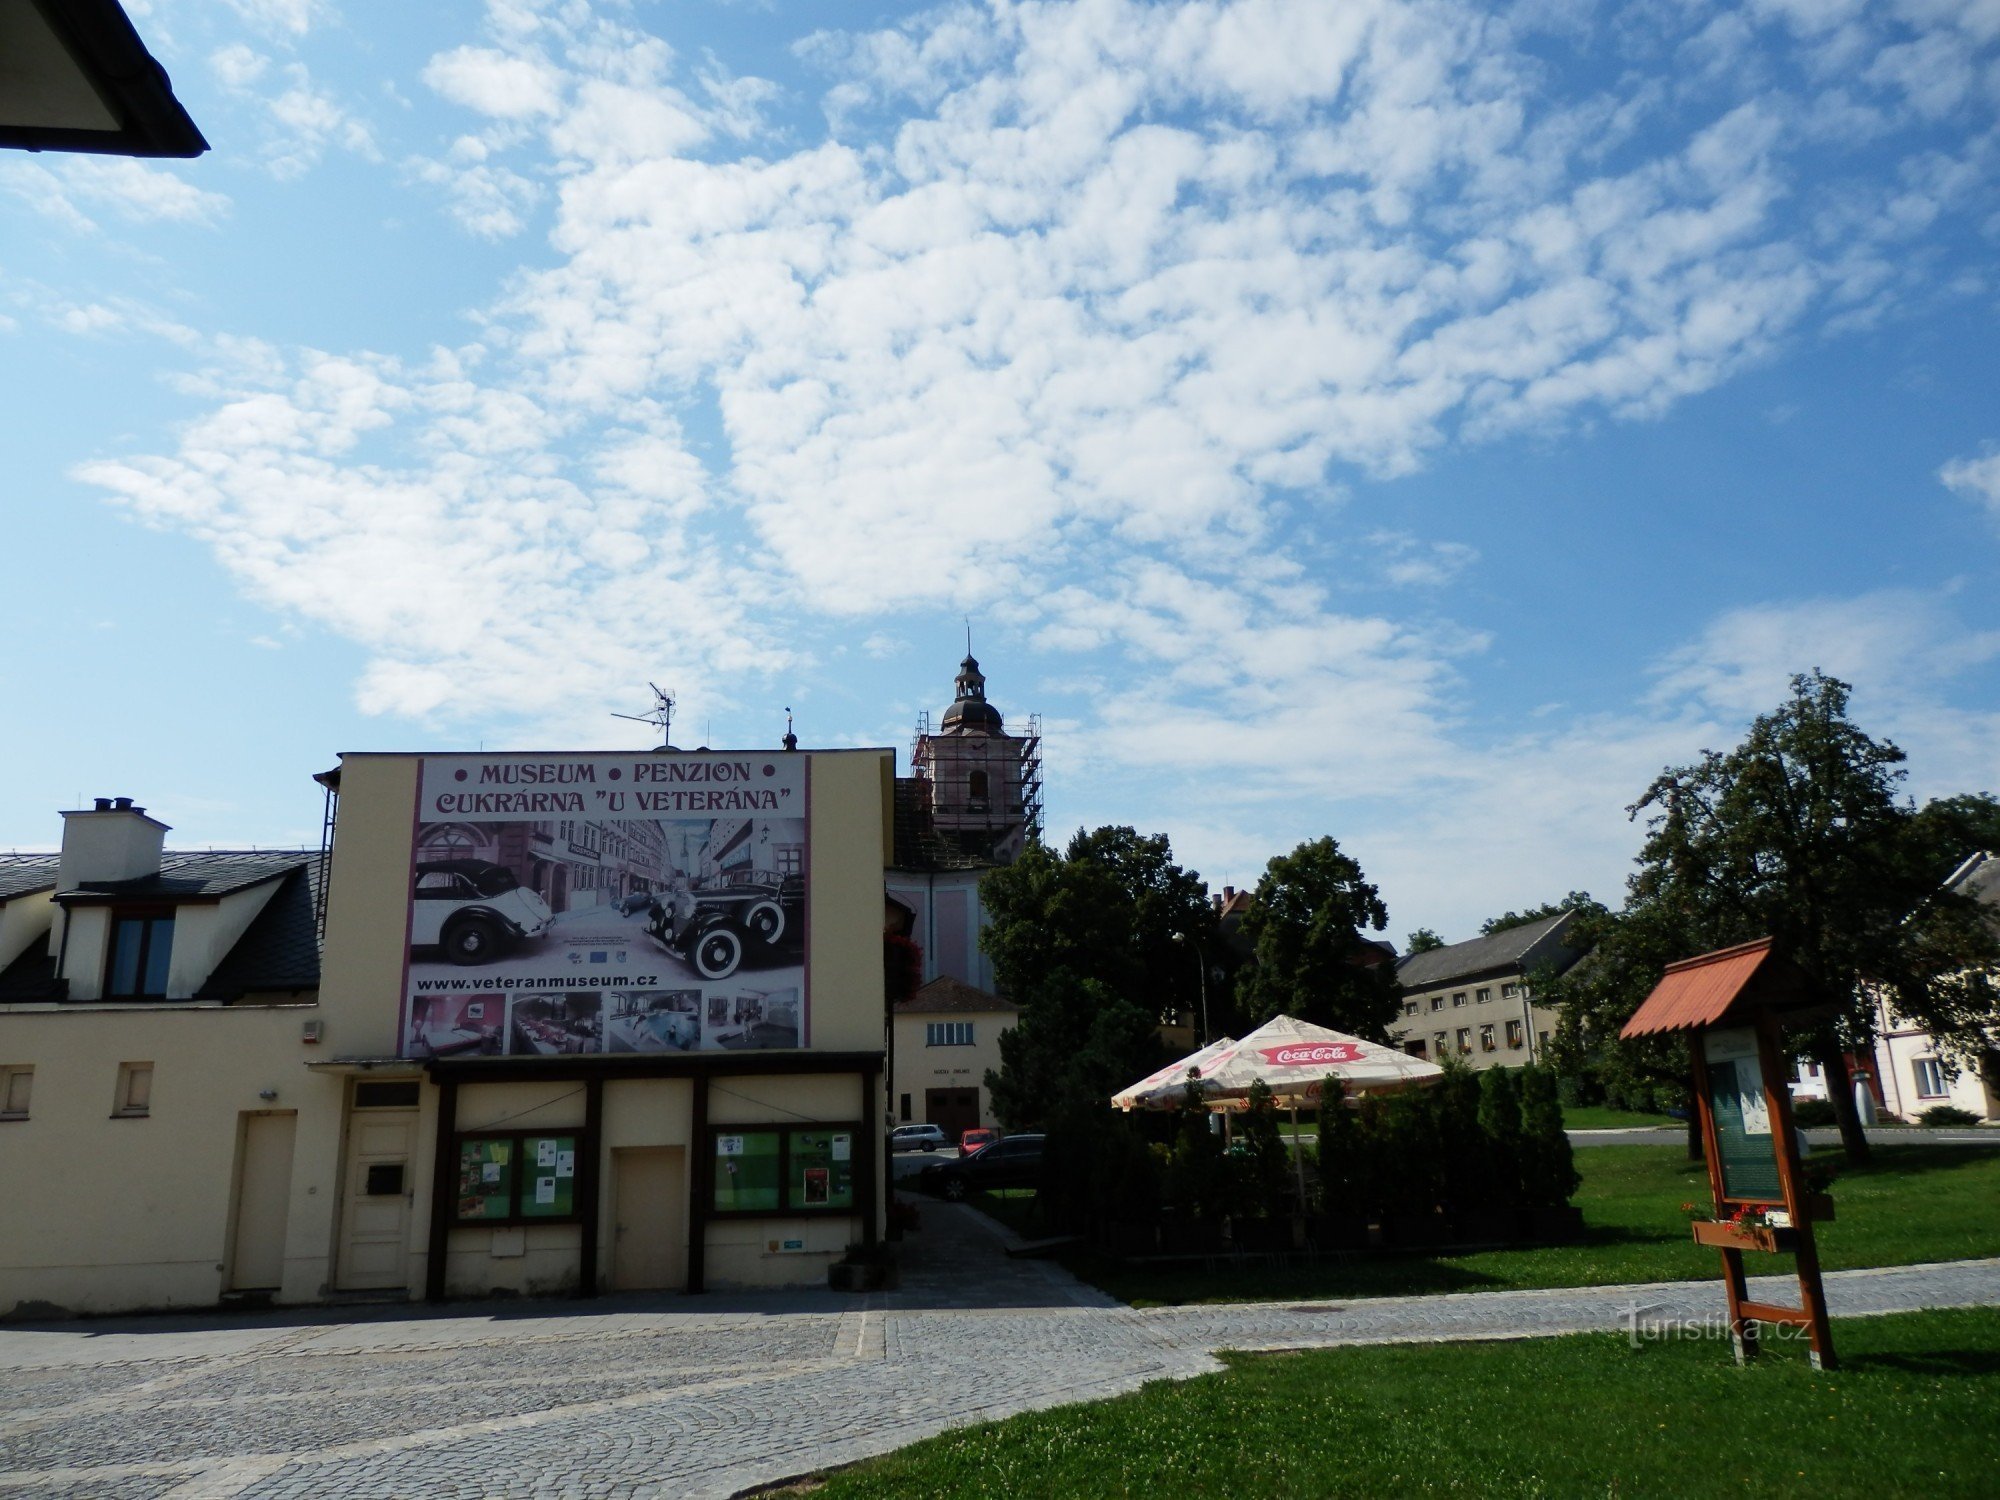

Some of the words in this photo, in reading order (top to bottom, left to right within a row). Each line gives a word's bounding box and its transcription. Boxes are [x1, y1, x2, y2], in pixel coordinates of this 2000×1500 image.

[479, 763, 596, 785] MUSEUM
[633, 761, 751, 783] PENZION
[435, 788, 586, 814] CUKRÁRNA
[417, 972, 659, 991] www.veteranmuseum.cz
[1276, 1045, 1348, 1064] Coca-Cola
